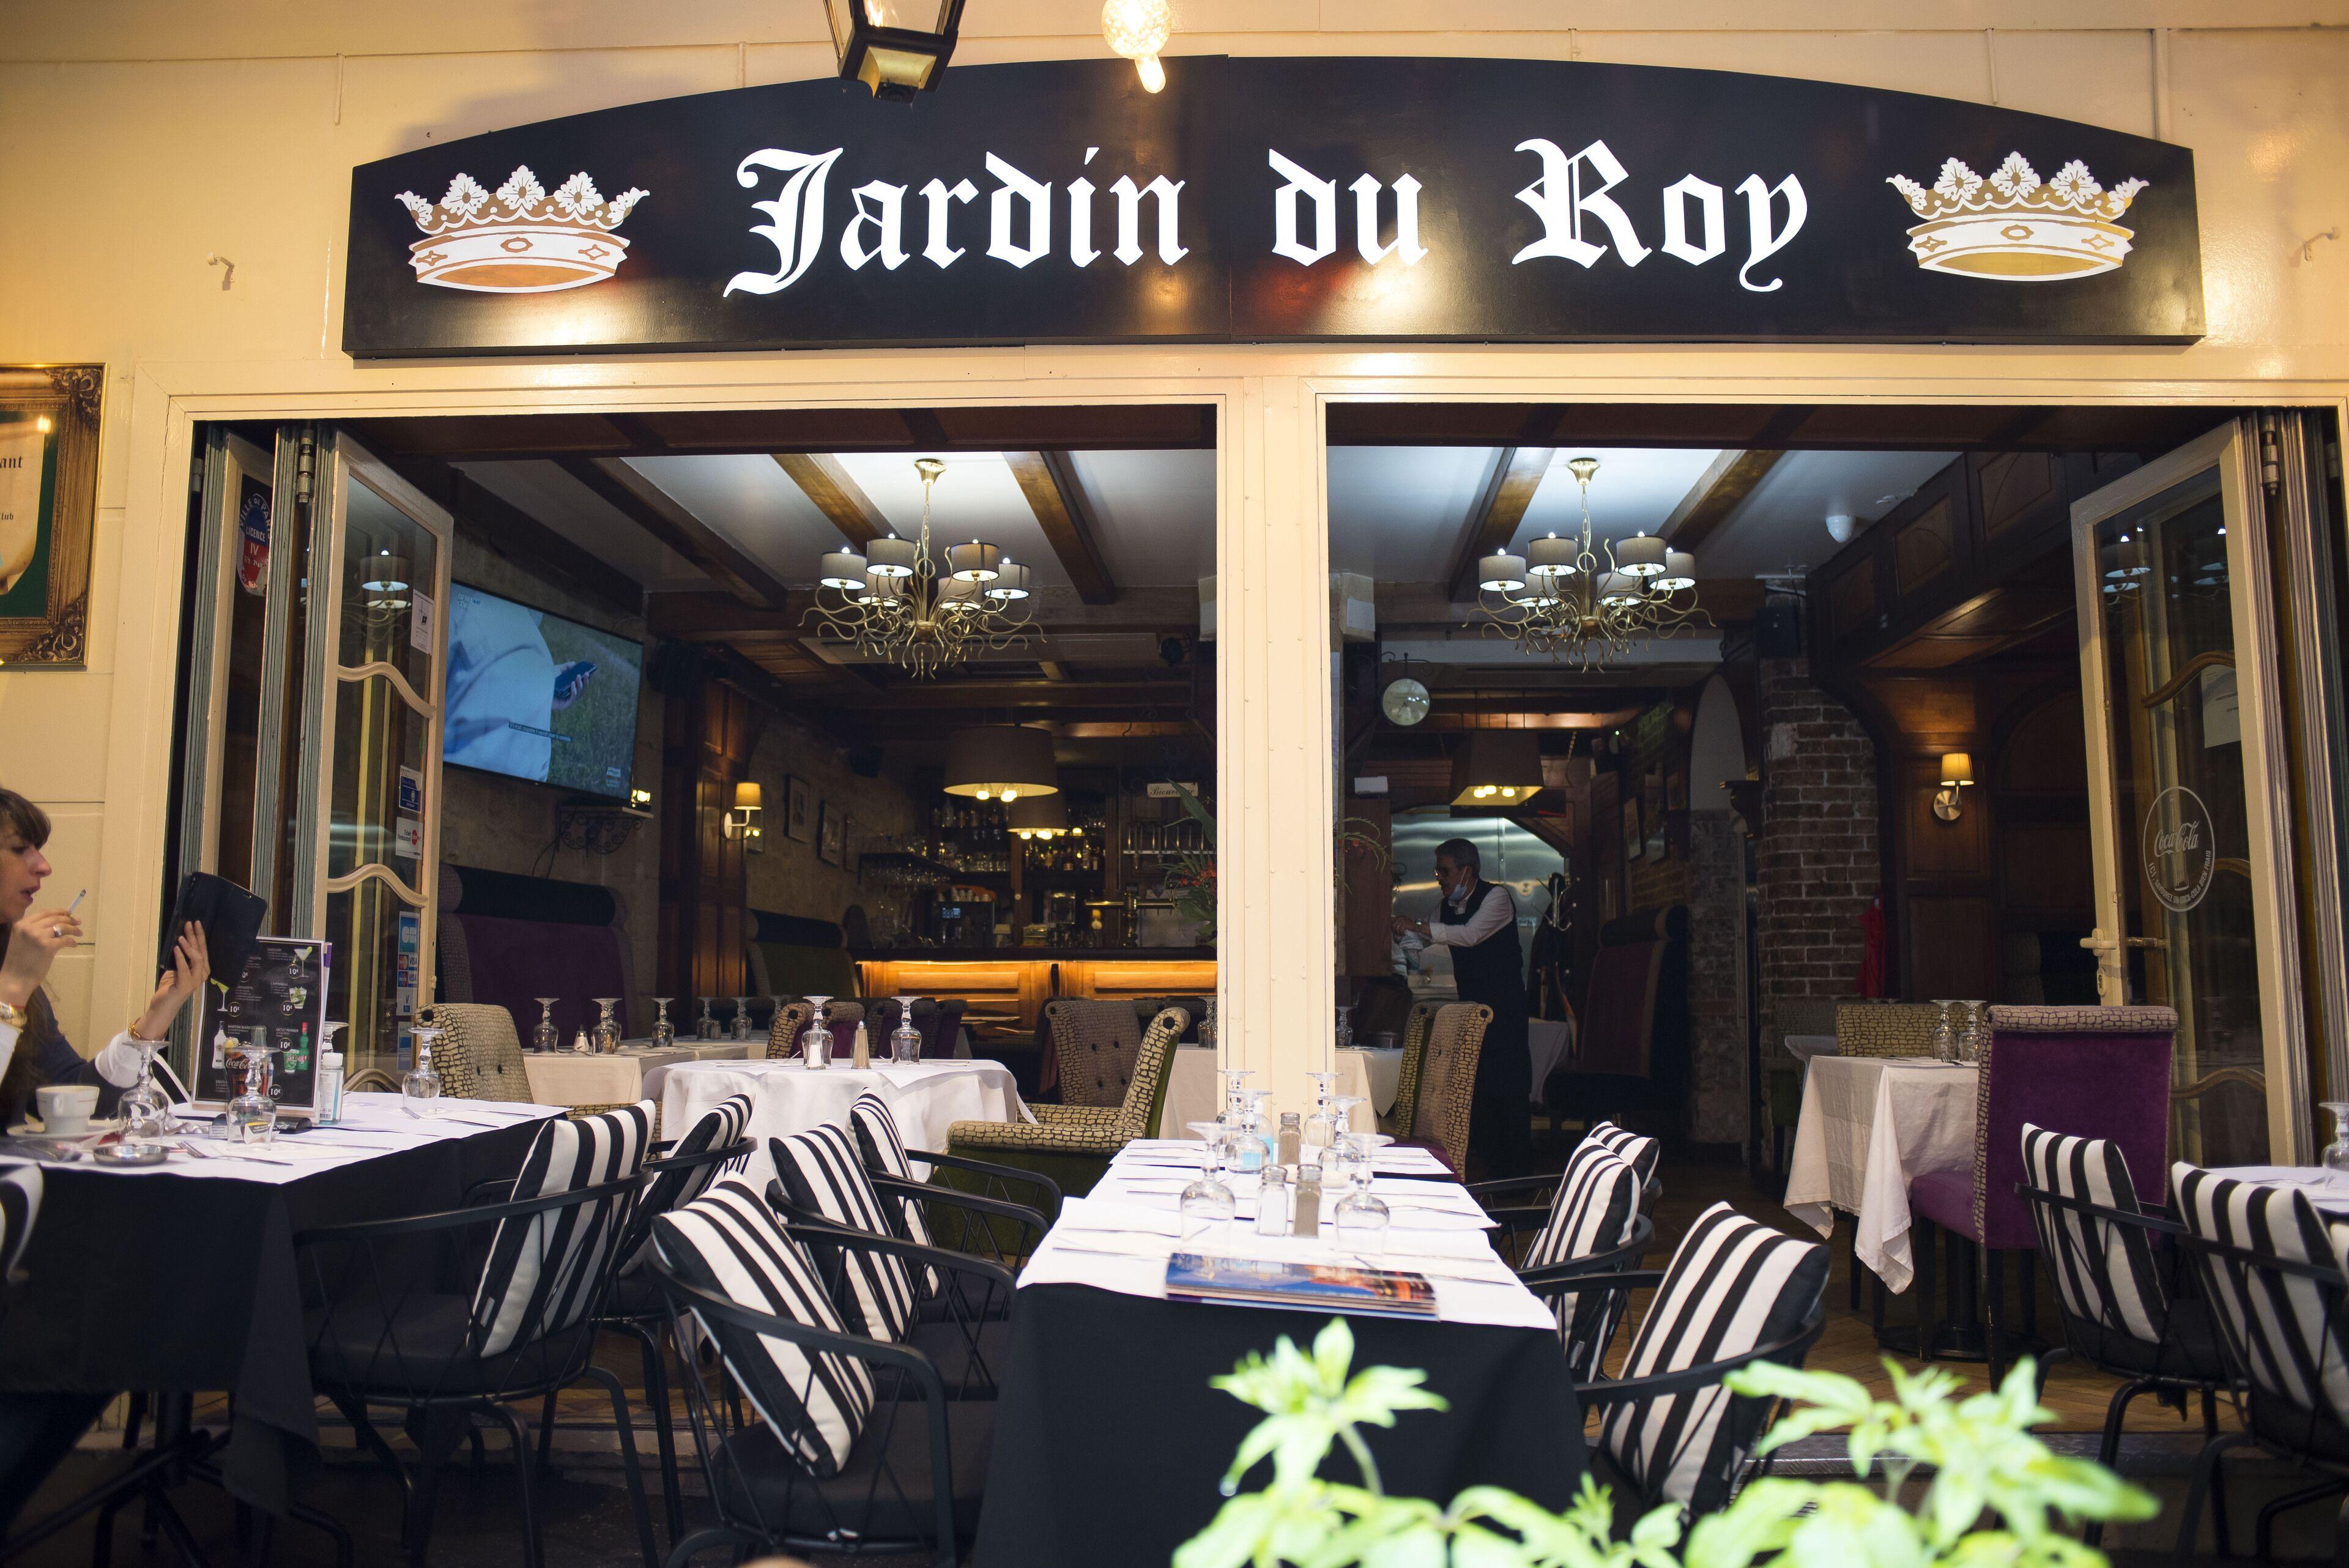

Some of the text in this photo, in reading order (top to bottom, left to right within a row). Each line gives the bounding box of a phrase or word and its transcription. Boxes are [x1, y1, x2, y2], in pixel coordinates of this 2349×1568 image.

[1268, 147, 1430, 267] du
[1511, 138, 1809, 293] Roy
[239, 498, 253, 527] VILLE
[246, 526, 265, 542] LICENCE
[250, 543, 259, 555] IV
[2154, 820, 2200, 858] Coca-Cola
